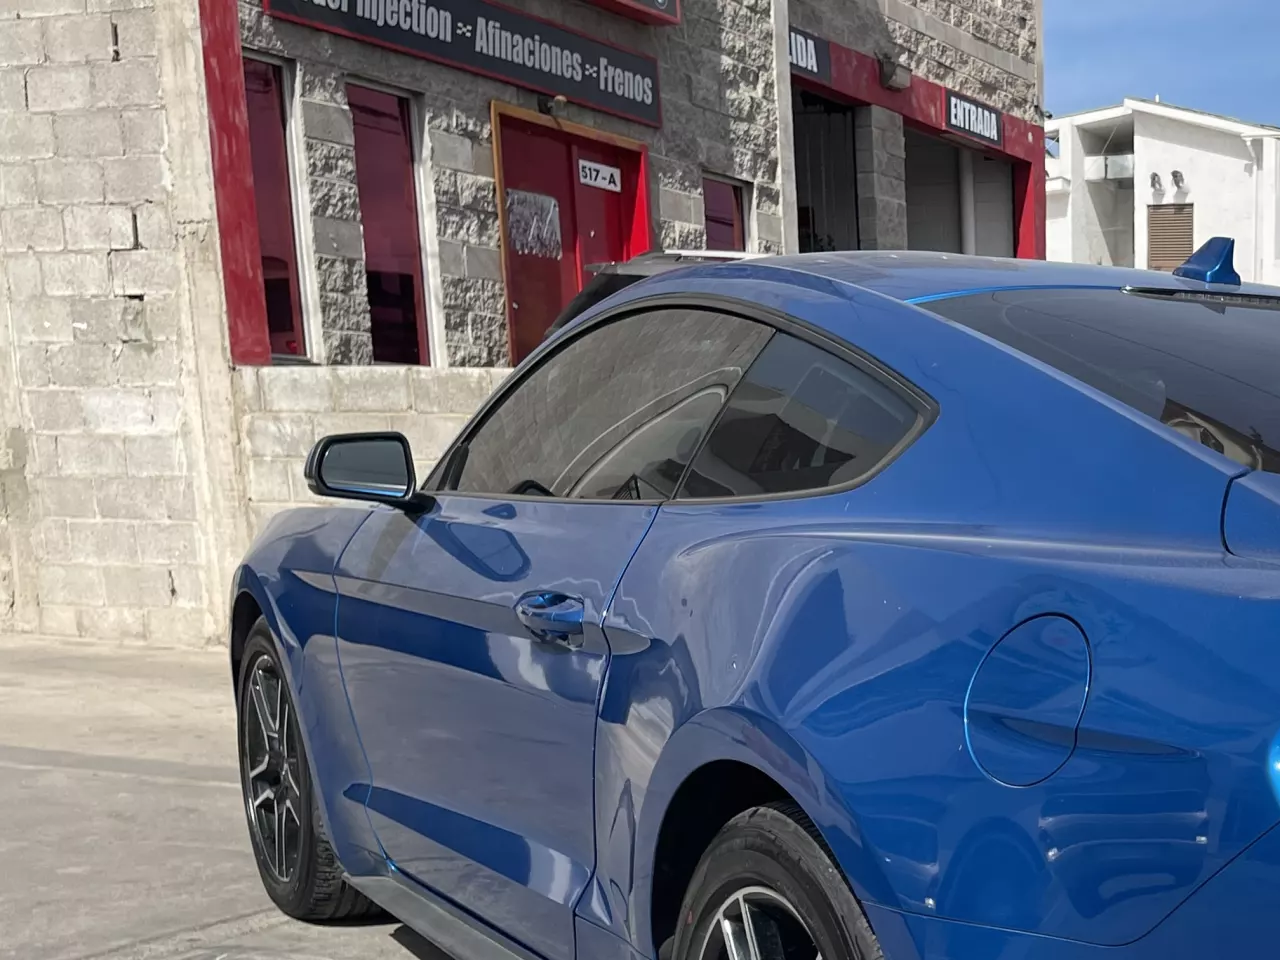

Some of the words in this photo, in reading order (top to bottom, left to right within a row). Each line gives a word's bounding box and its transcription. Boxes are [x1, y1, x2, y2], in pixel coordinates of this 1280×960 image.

[475, 16, 582, 82] Afinaciones
[599, 57, 653, 105] Frenos
[950, 96, 998, 141] ENTRADA
[581, 164, 617, 187] 517-A
